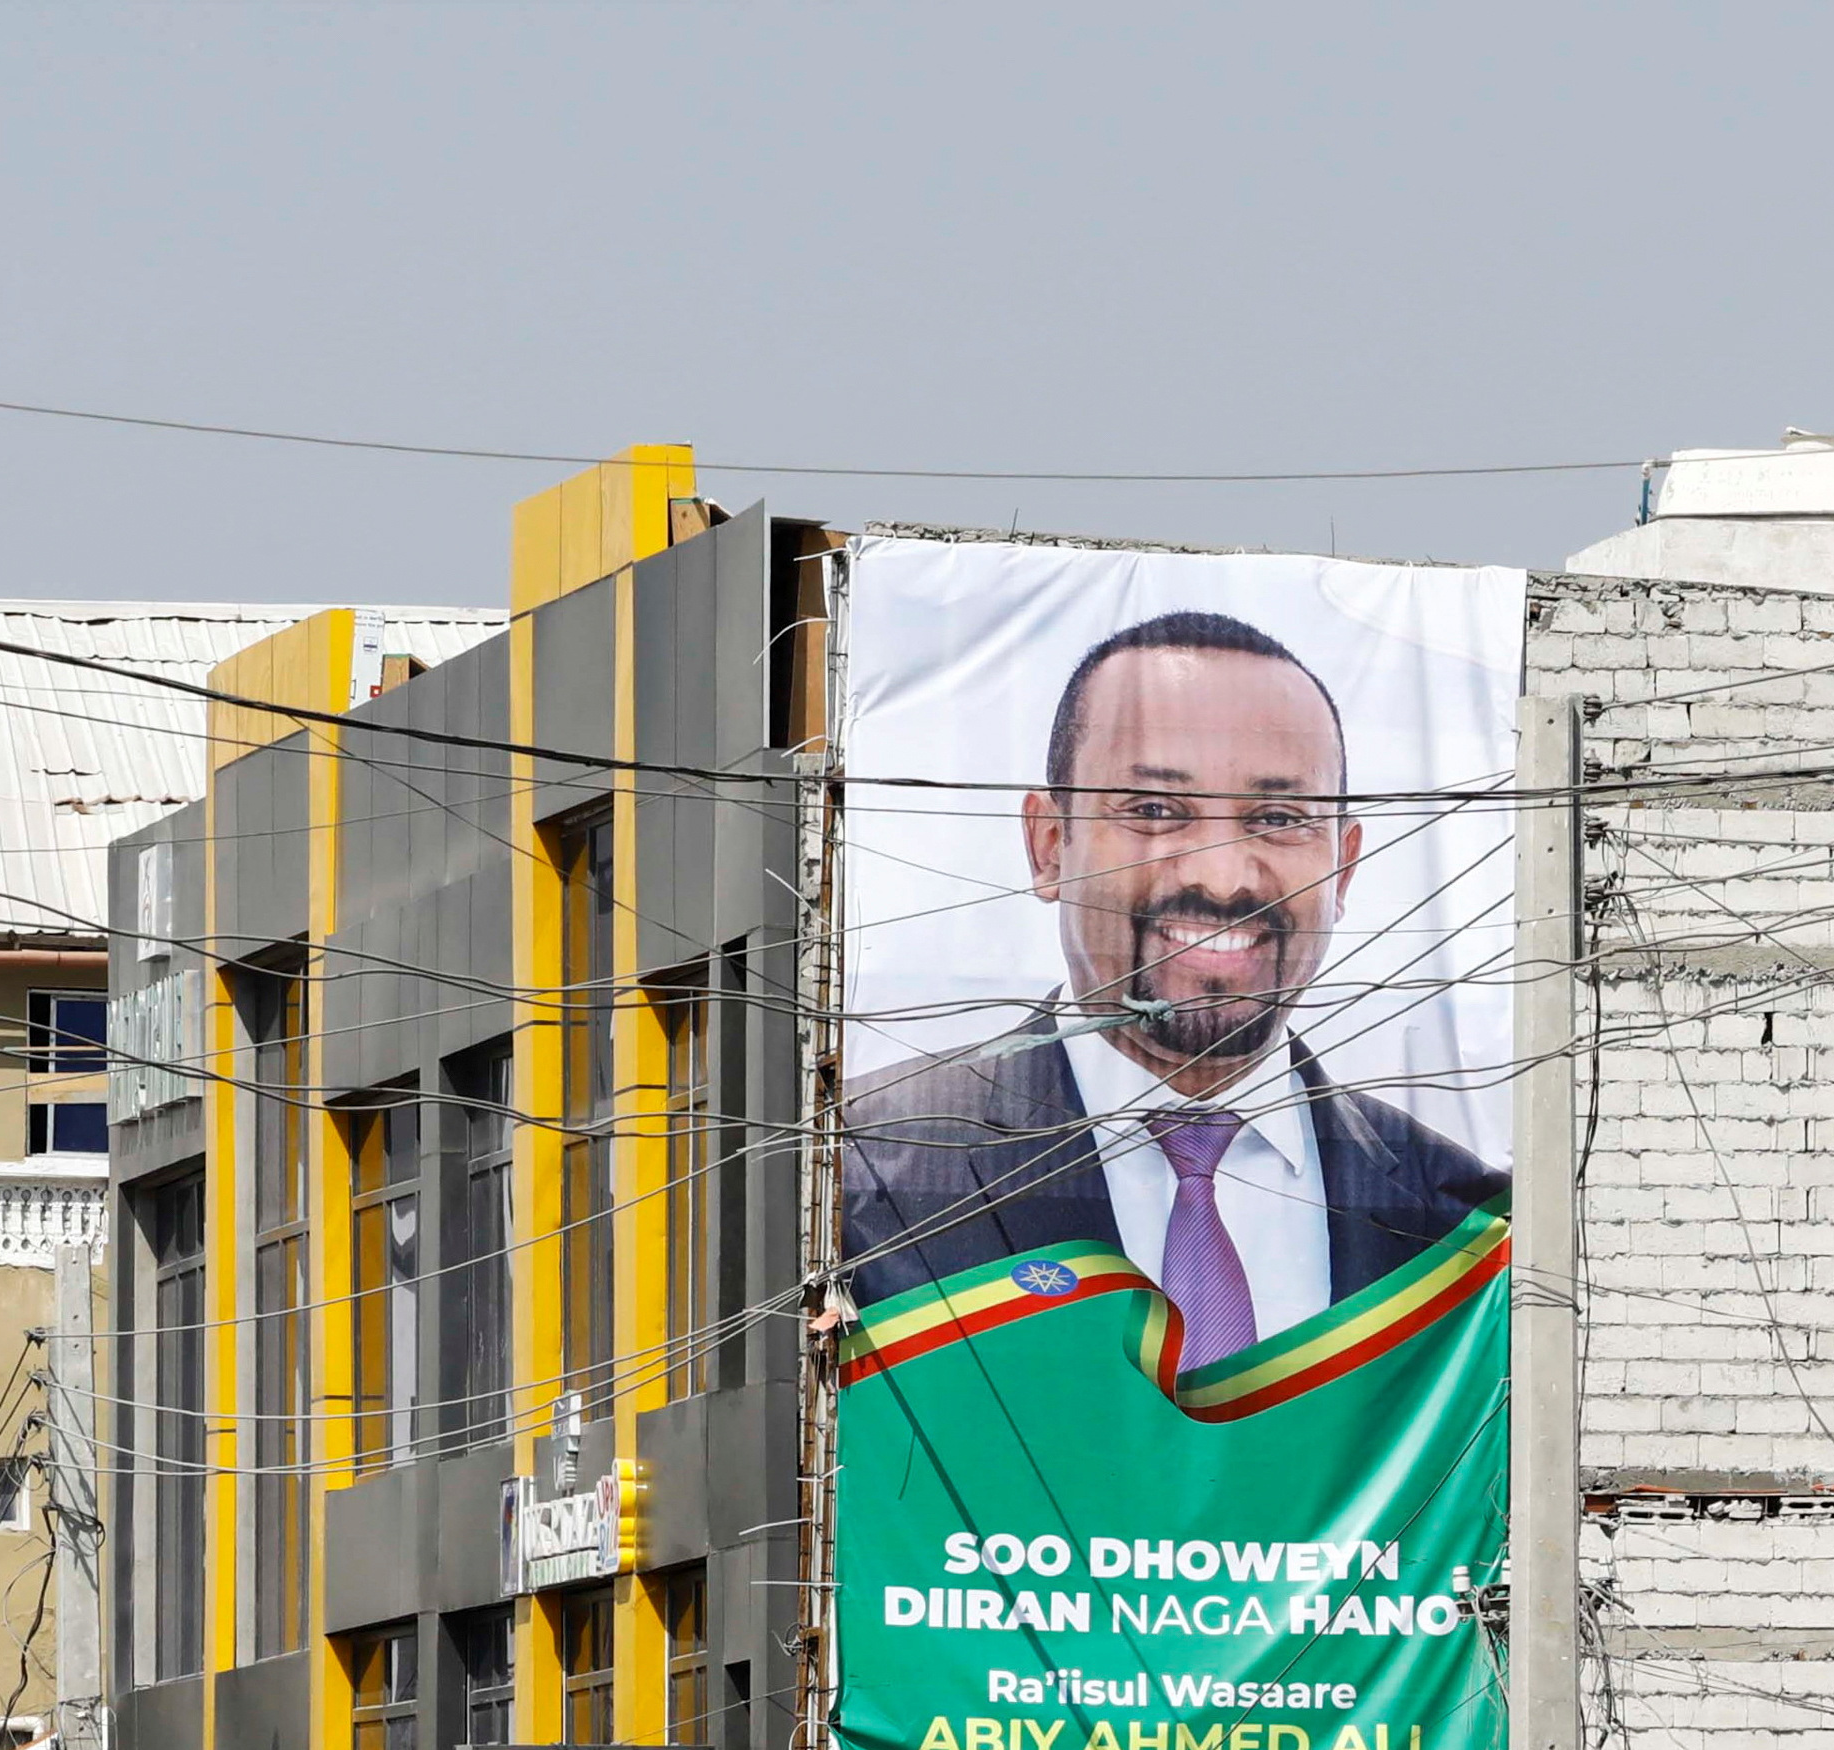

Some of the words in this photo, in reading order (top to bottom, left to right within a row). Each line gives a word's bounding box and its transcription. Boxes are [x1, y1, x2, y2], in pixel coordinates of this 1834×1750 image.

[944, 1532, 1070, 1575] SOO
[1088, 1537, 1401, 1582] DHOWEYN
[884, 1586, 1091, 1633] DIIRAN
[1111, 1594, 1275, 1636] NAGA
[1289, 1594, 1459, 1636] HANO
[1165, 1673, 1357, 1710] Wasaare
